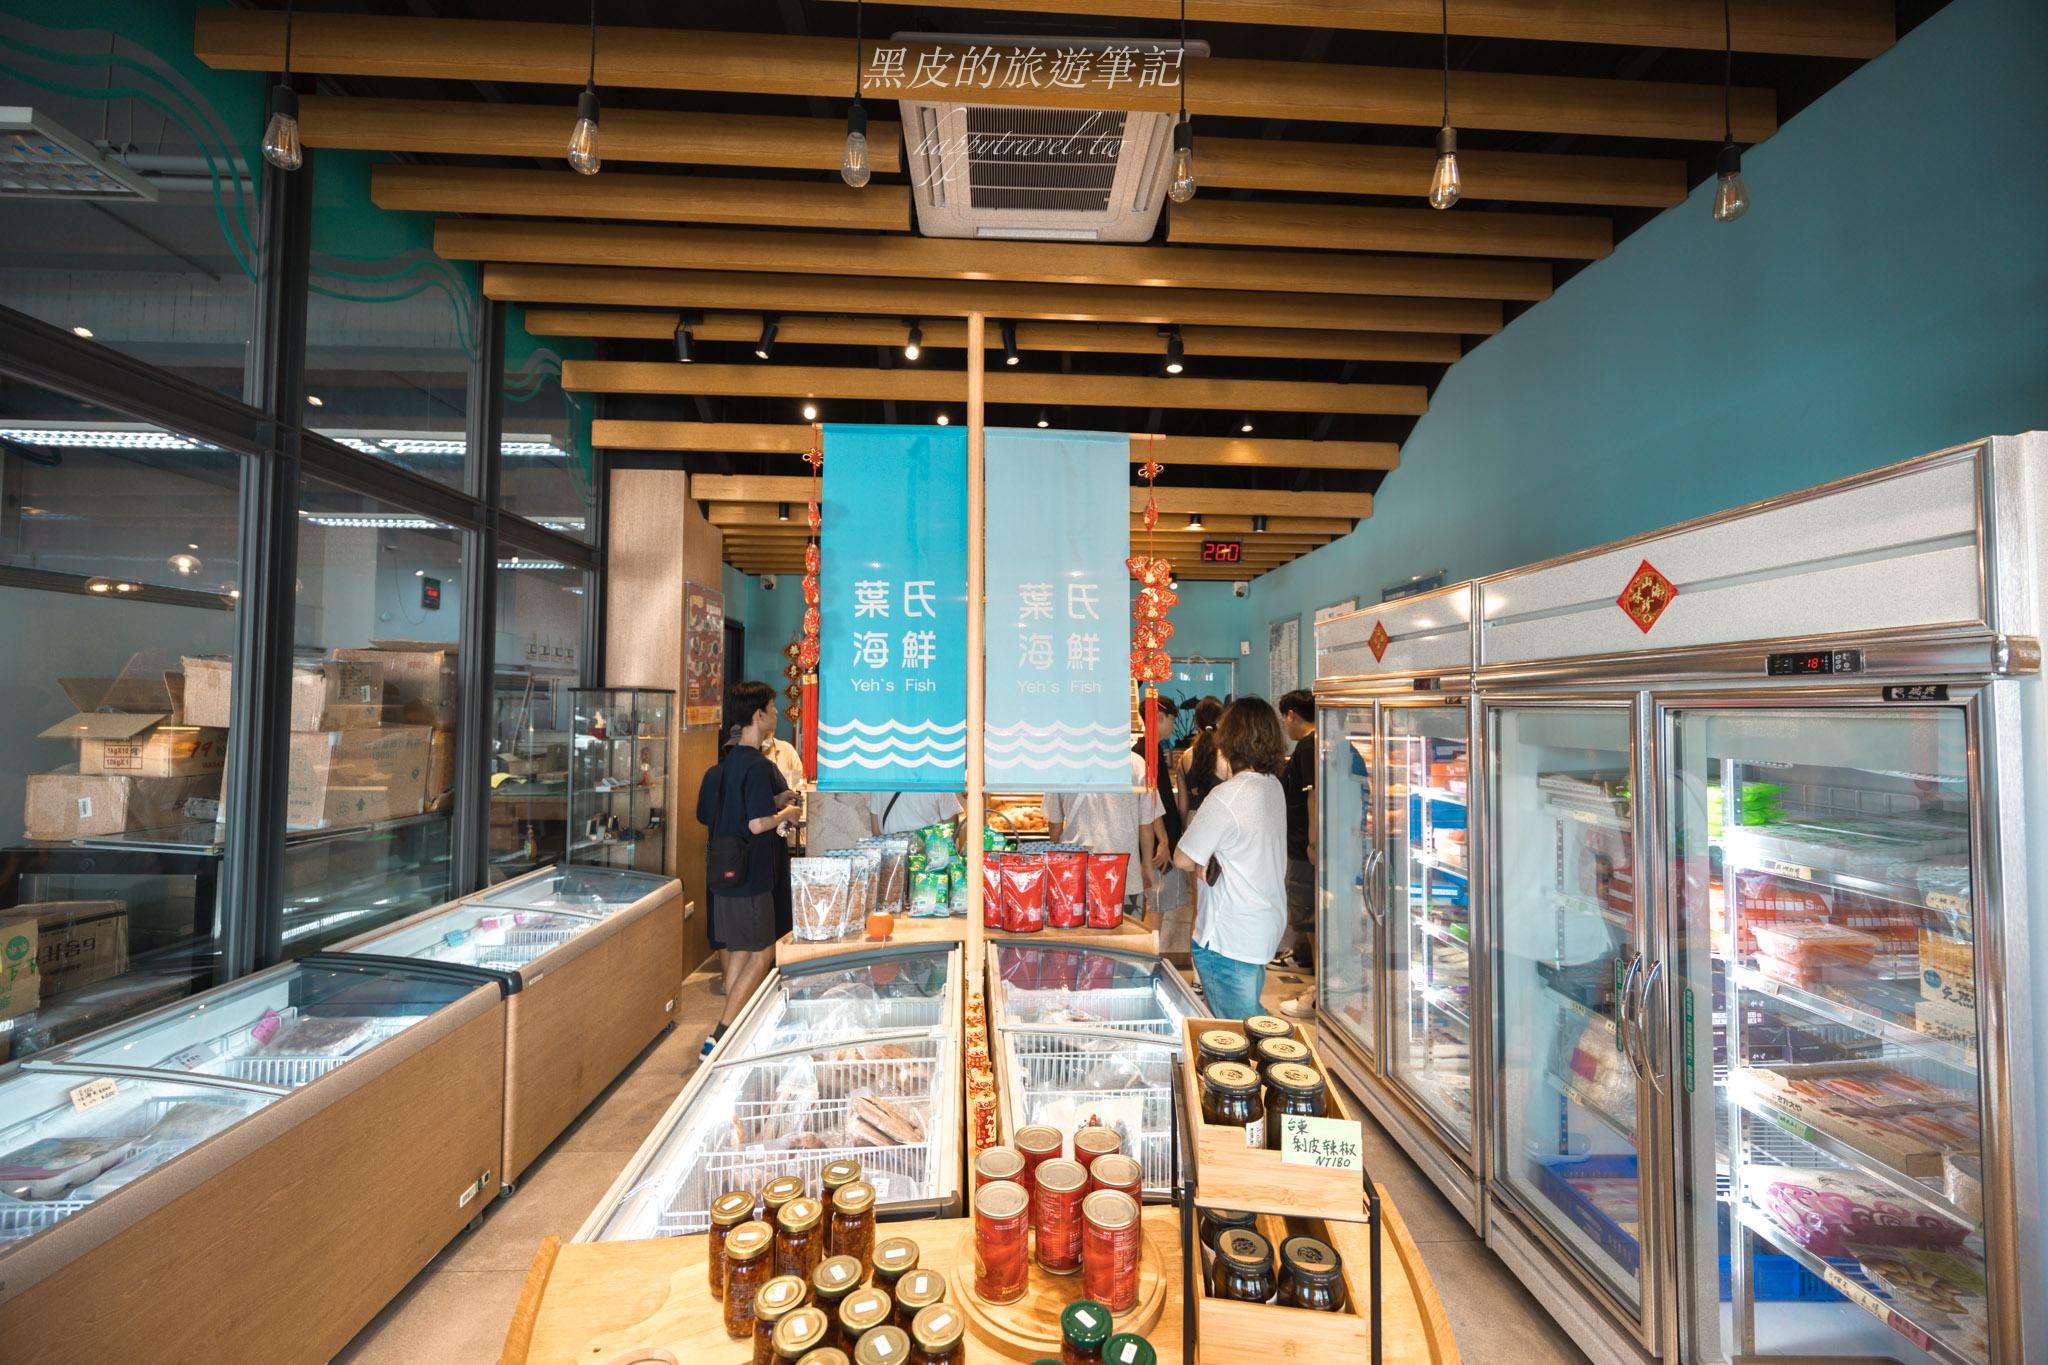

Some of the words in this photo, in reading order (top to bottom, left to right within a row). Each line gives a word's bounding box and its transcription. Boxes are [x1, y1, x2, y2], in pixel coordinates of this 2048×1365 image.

[854, 580, 936, 618] 葉氏
[1019, 583, 1100, 620] 葉氏
[853, 631, 936, 669] 海鮮
[1019, 632, 1100, 671] 海鮮
[905, 679, 936, 692] Fish
[1070, 680, 1101, 694] Fish
[1288, 1118, 1309, 1135] 台東
[1316, 1156, 1351, 1168] NT180
